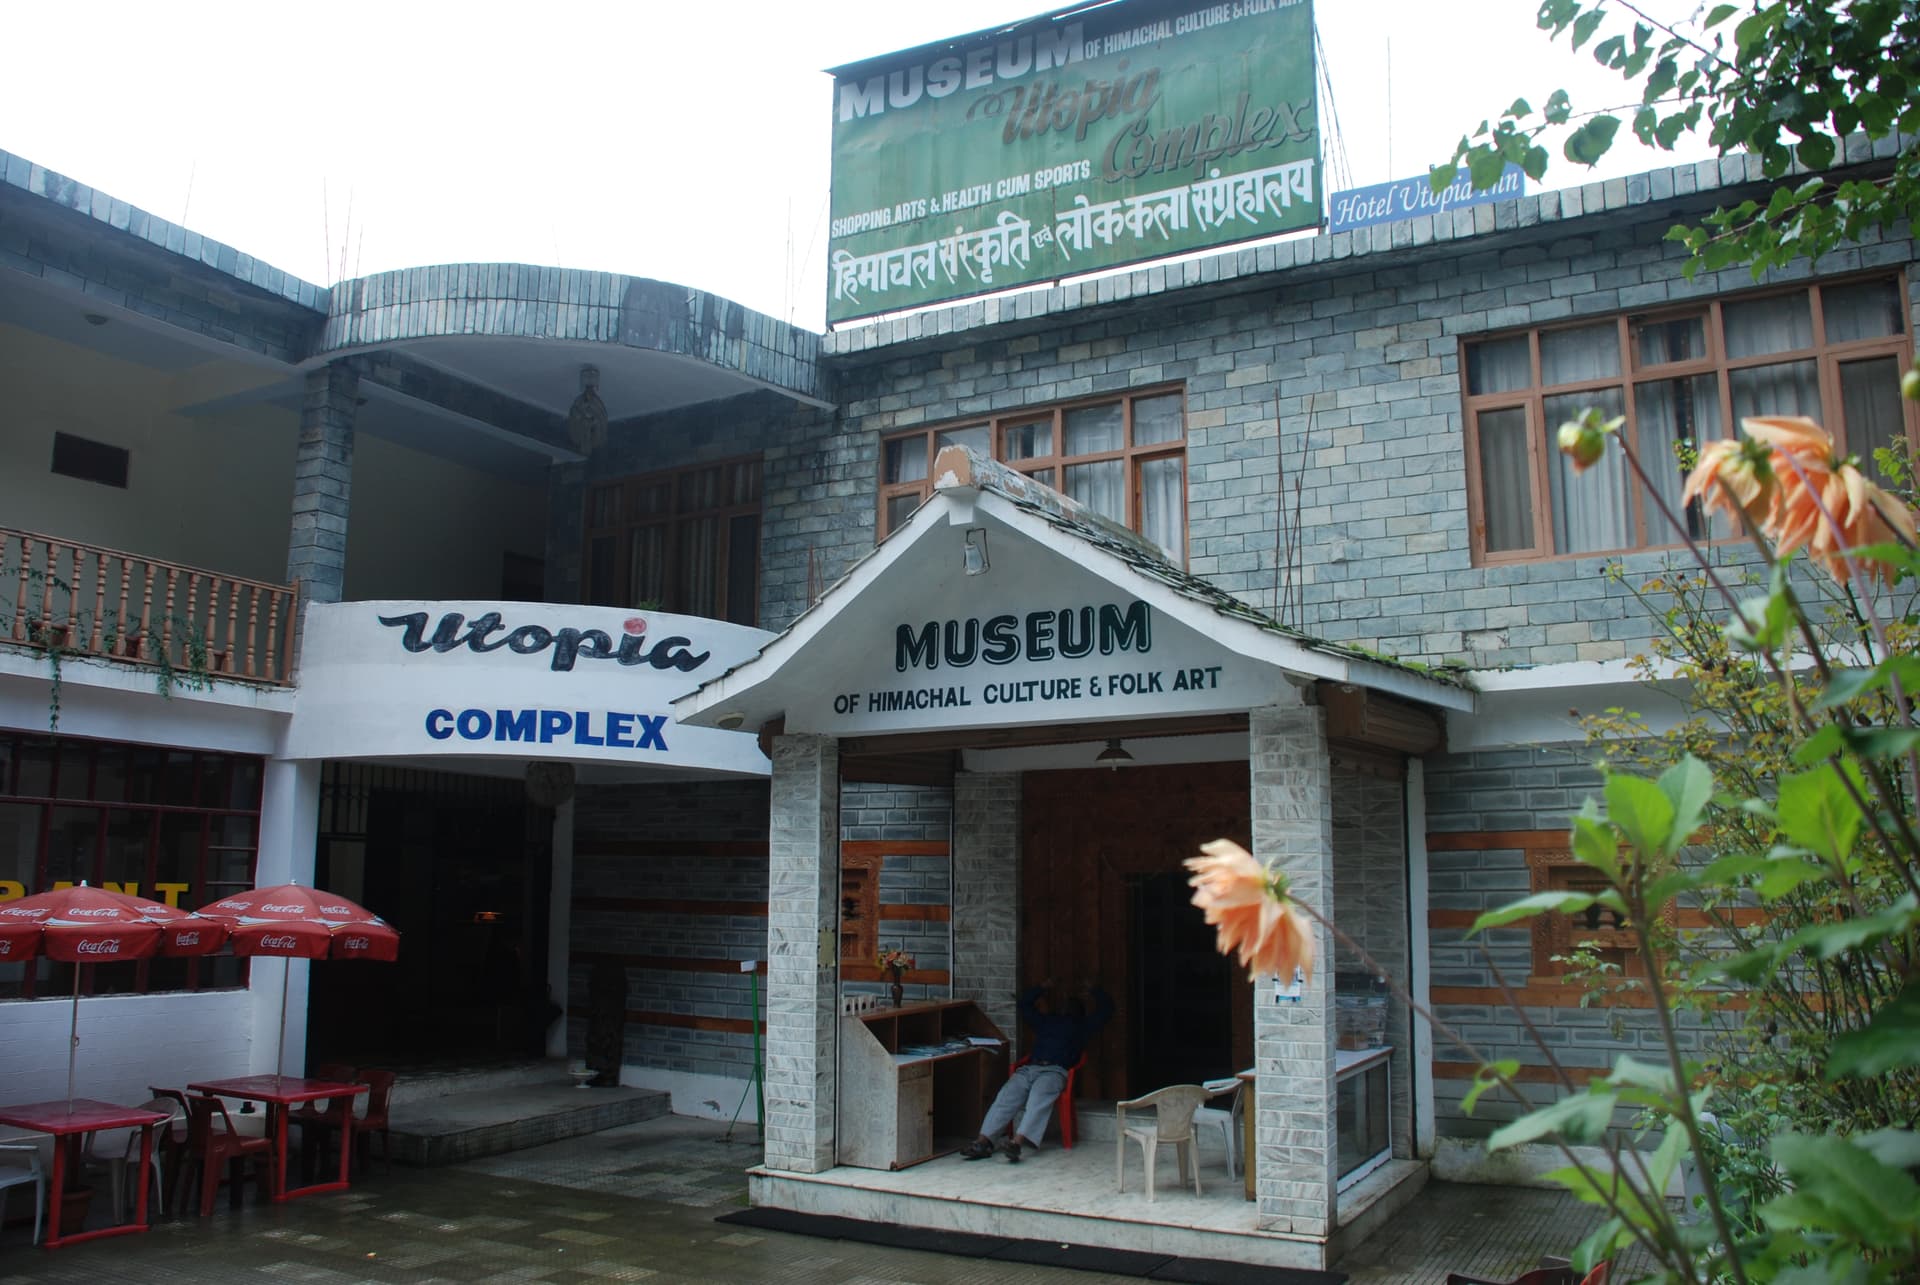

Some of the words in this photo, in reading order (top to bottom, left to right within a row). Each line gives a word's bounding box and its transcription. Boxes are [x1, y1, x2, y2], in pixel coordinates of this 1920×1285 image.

[1085, 38, 1101, 60] OF
[1104, 18, 1173, 54] HIMACHAL
[1175, 7, 1230, 35] CULTURE
[840, 21, 1084, 122] MUSEUM
[1101, 91, 1319, 183] Complex
[930, 198, 940, 213] &
[942, 183, 991, 211] HEALTH
[997, 174, 1030, 199] CUM
[1034, 160, 1091, 190] SPORTS
[1336, 185, 1398, 226] Hotel
[1400, 175, 1473, 213] Utopia
[1480, 172, 1519, 197] nn
[832, 249, 938, 304] हिमाचल
[936, 210, 1031, 285] संस्कृति
[1191, 158, 1315, 232] संग्रहालय
[378, 611, 710, 672] Utopia
[896, 599, 1151, 673] MUSEUM
[833, 693, 860, 714] OF
[868, 685, 971, 713] HIMACHAL
[983, 677, 1082, 704] CULTURE
[1090, 675, 1101, 697] &
[1109, 671, 1163, 696] FOLK
[1172, 666, 1222, 692] ART
[425, 708, 669, 751] COMPLEX
